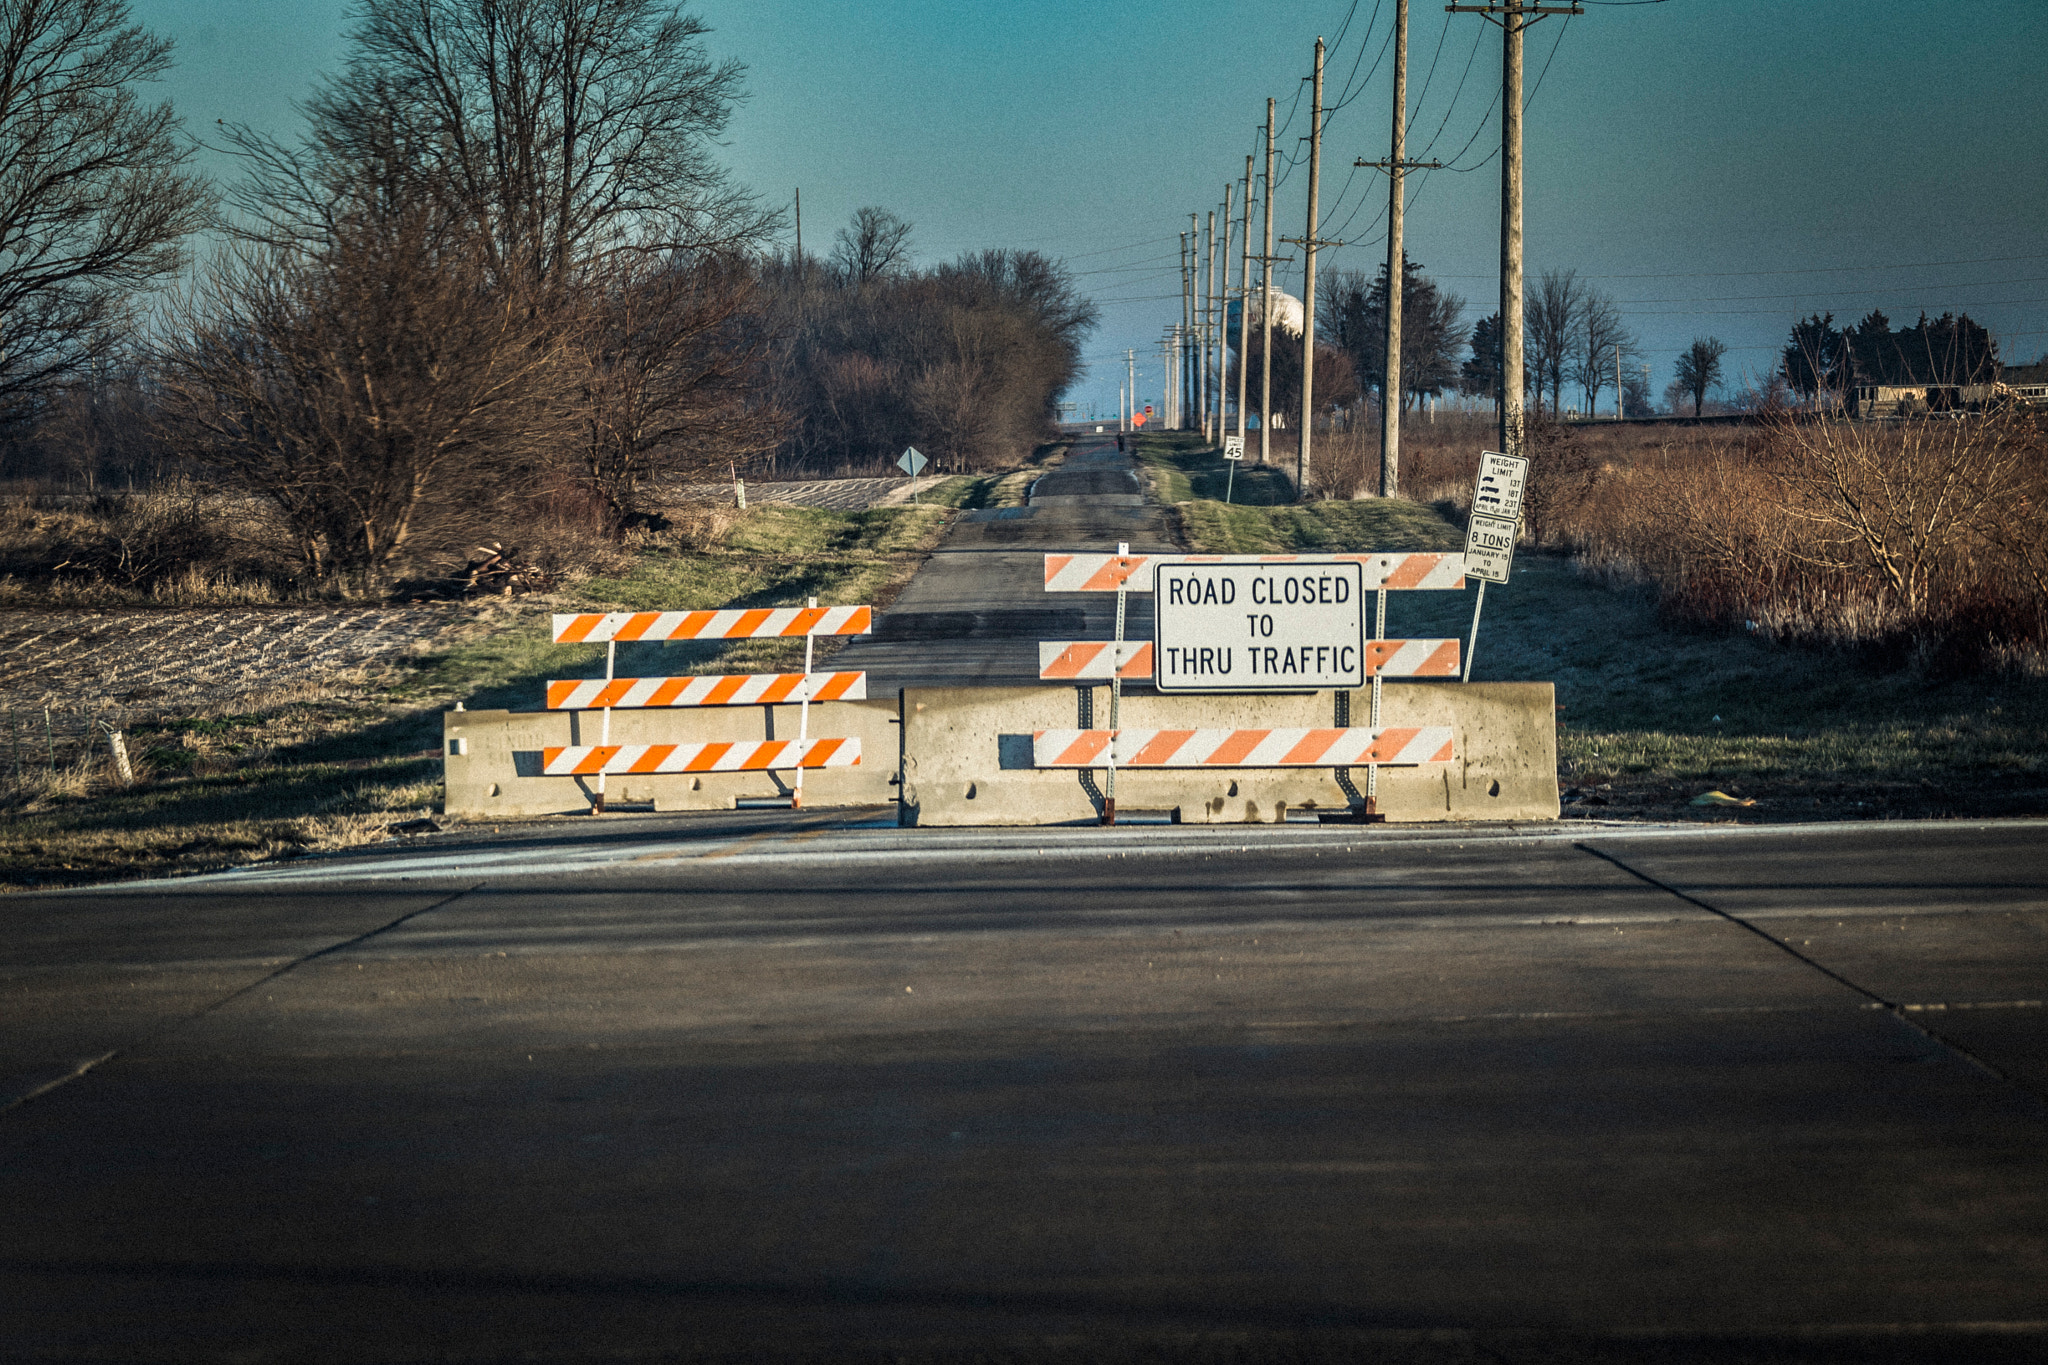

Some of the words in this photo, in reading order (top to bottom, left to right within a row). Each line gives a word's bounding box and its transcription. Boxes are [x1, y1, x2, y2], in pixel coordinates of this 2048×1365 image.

[1227, 447, 1242, 458] 45
[1490, 457, 1519, 469] WEIGHT
[1492, 467, 1513, 477] LIMIT
[1510, 479, 1521, 487] 13T
[1508, 489, 1519, 497] 18T
[1504, 499, 1517, 508] 23T
[1476, 519, 1495, 528] WEIGHT
[1497, 523, 1511, 531] LIMIT
[1471, 531, 1478, 543] 8
[1483, 533, 1511, 548] TONS
[1468, 548, 1499, 558] JANUARY
[1501, 553, 1508, 561] 15
[1483, 559, 1491, 567] TO
[1471, 567, 1490, 577] APRIL
[1492, 570, 1499, 578] 15
[1169, 577, 1236, 605] ROAD
[1252, 576, 1350, 605] CLOSED
[1246, 613, 1274, 637] TO
[1166, 646, 1232, 675] THRU
[1248, 645, 1355, 674] TRAFFIC
